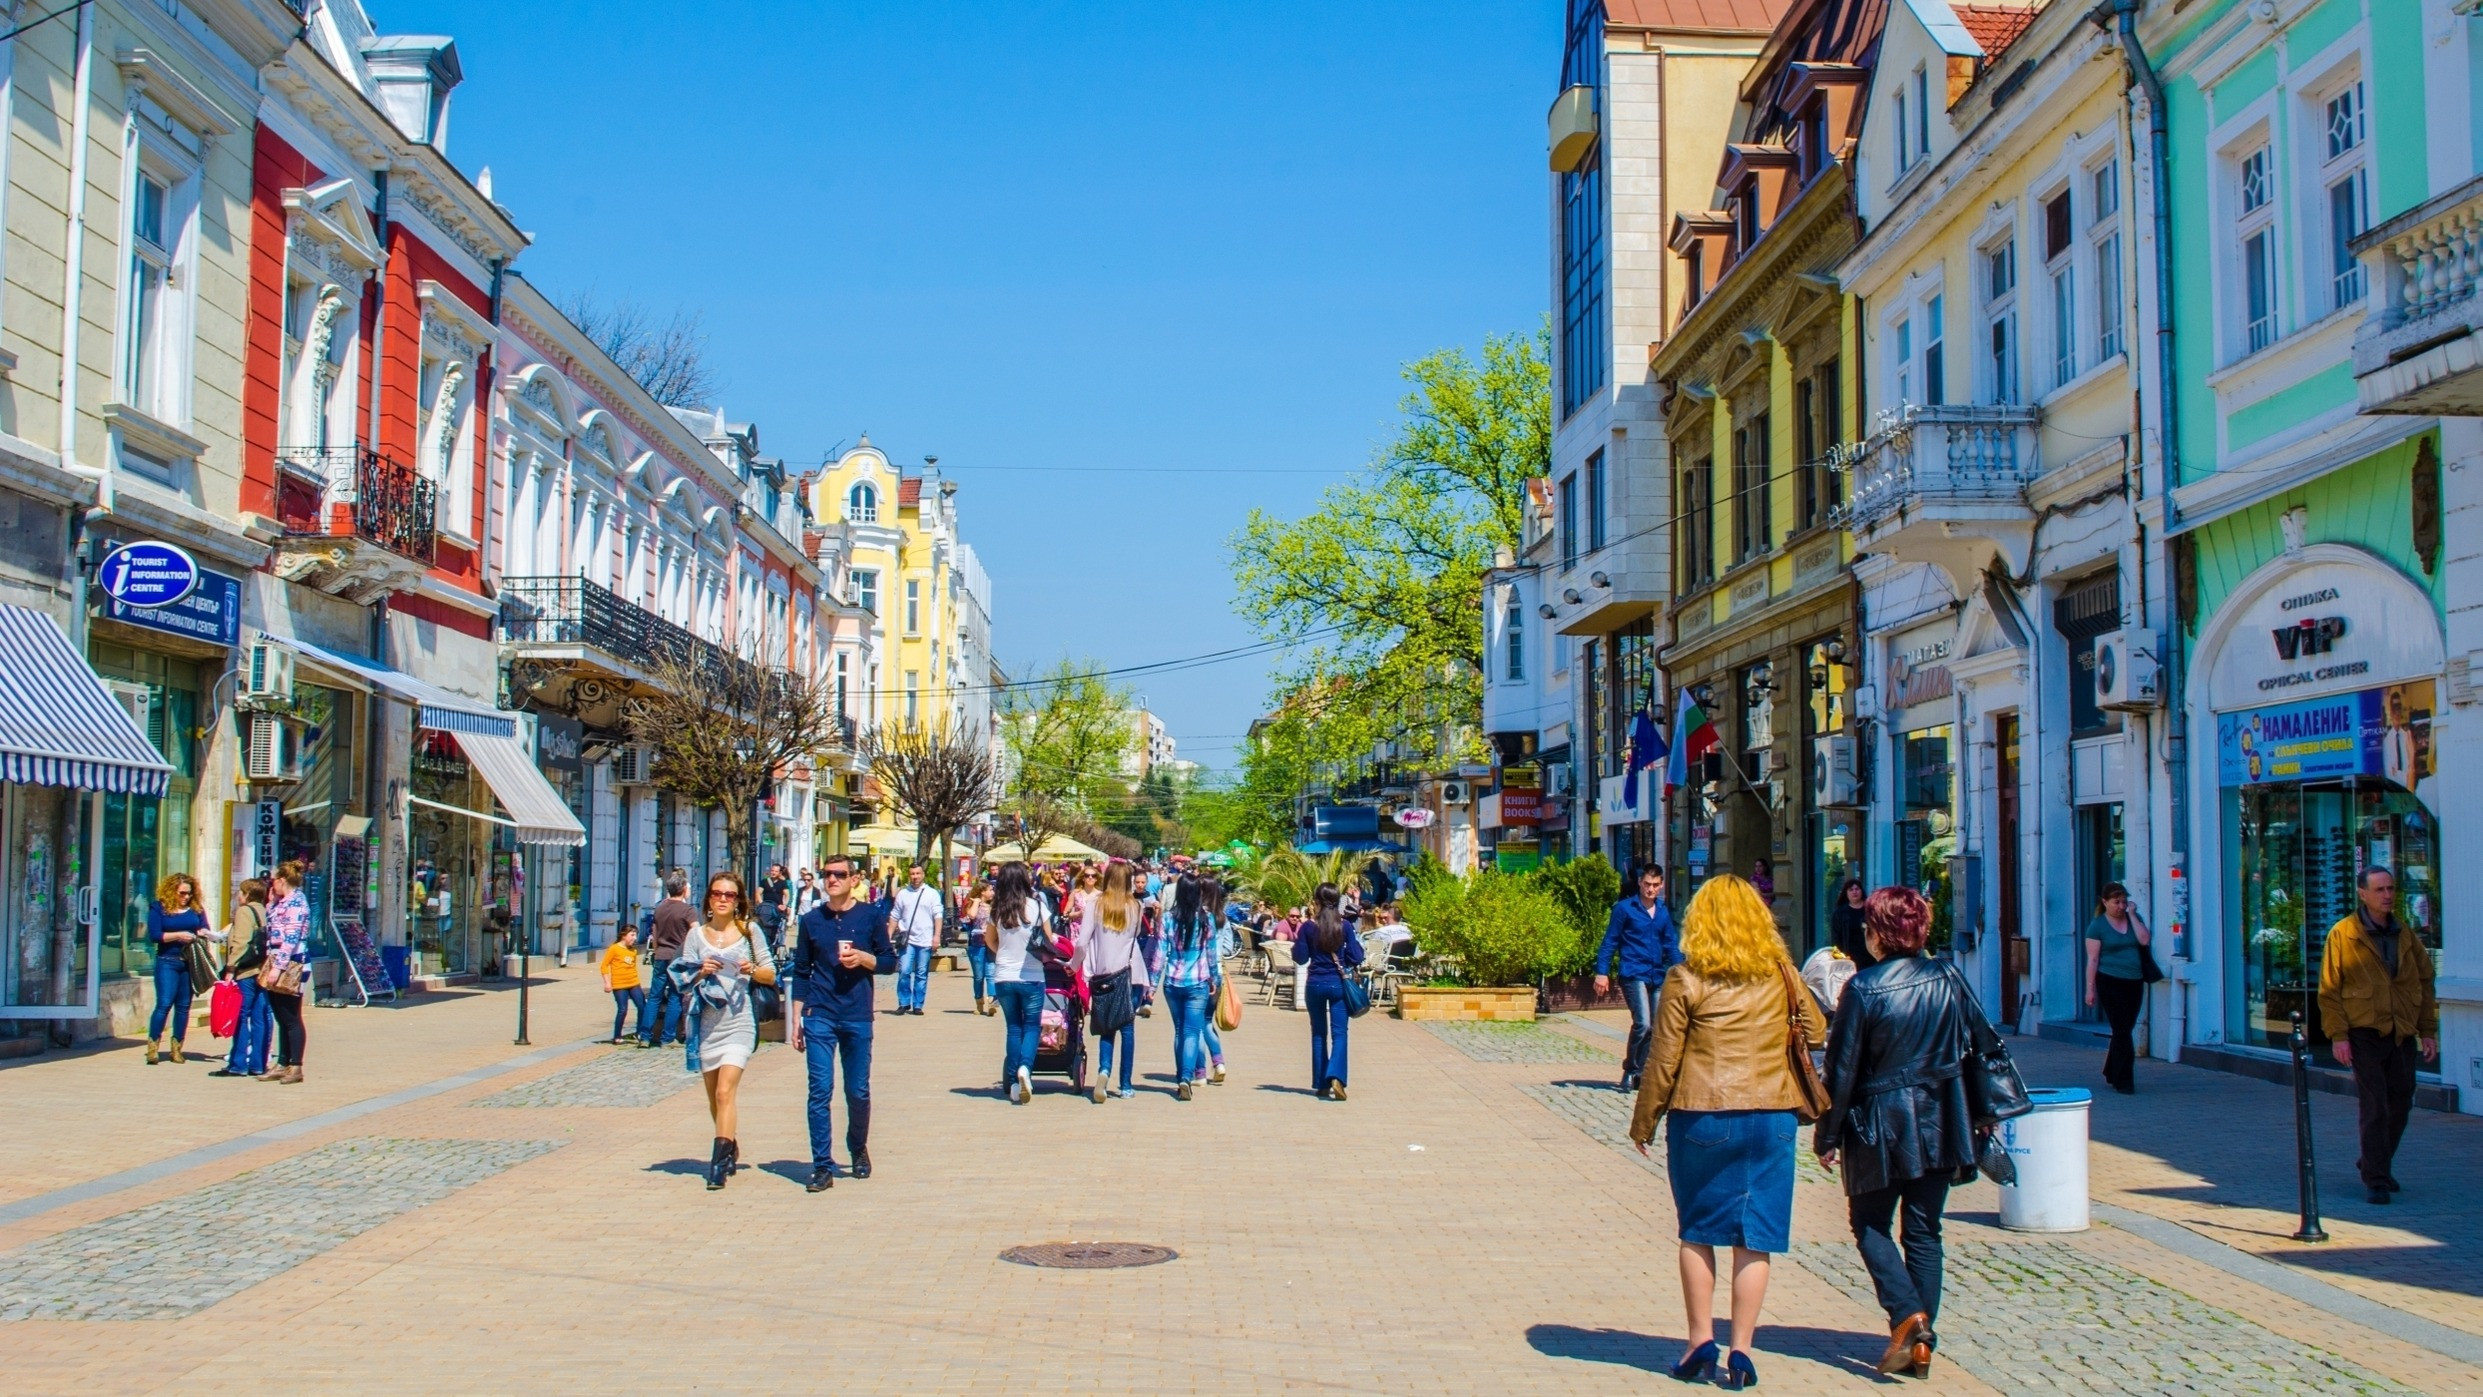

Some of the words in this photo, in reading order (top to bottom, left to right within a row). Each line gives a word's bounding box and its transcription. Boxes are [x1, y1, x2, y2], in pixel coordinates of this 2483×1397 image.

[131, 558, 168, 567] TOURIST
[131, 571, 190, 579] INFORMATION
[130, 584, 165, 592] CENTRE
[196, 596, 219, 614] ЦЕНТЪР
[2281, 588, 2340, 611] ОПТИКА
[131, 607, 157, 621] TOURIST
[157, 610, 196, 630] INFORMATION
[197, 620, 219, 636] CENTRE
[1907, 639, 1954, 665] МАГАЗИ
[2258, 671, 2313, 690] OPTICAL
[2315, 661, 2369, 681] CENTER
[2263, 705, 2350, 742] НАМАЛЕНИЕ
[445, 760, 465, 775] BAGS
[1504, 796, 1537, 806] КНИГИ
[1504, 808, 1536, 818] BOOKS
[258, 803, 276, 866] КОЖЕНИ
[1906, 825, 1918, 890] MANDER
